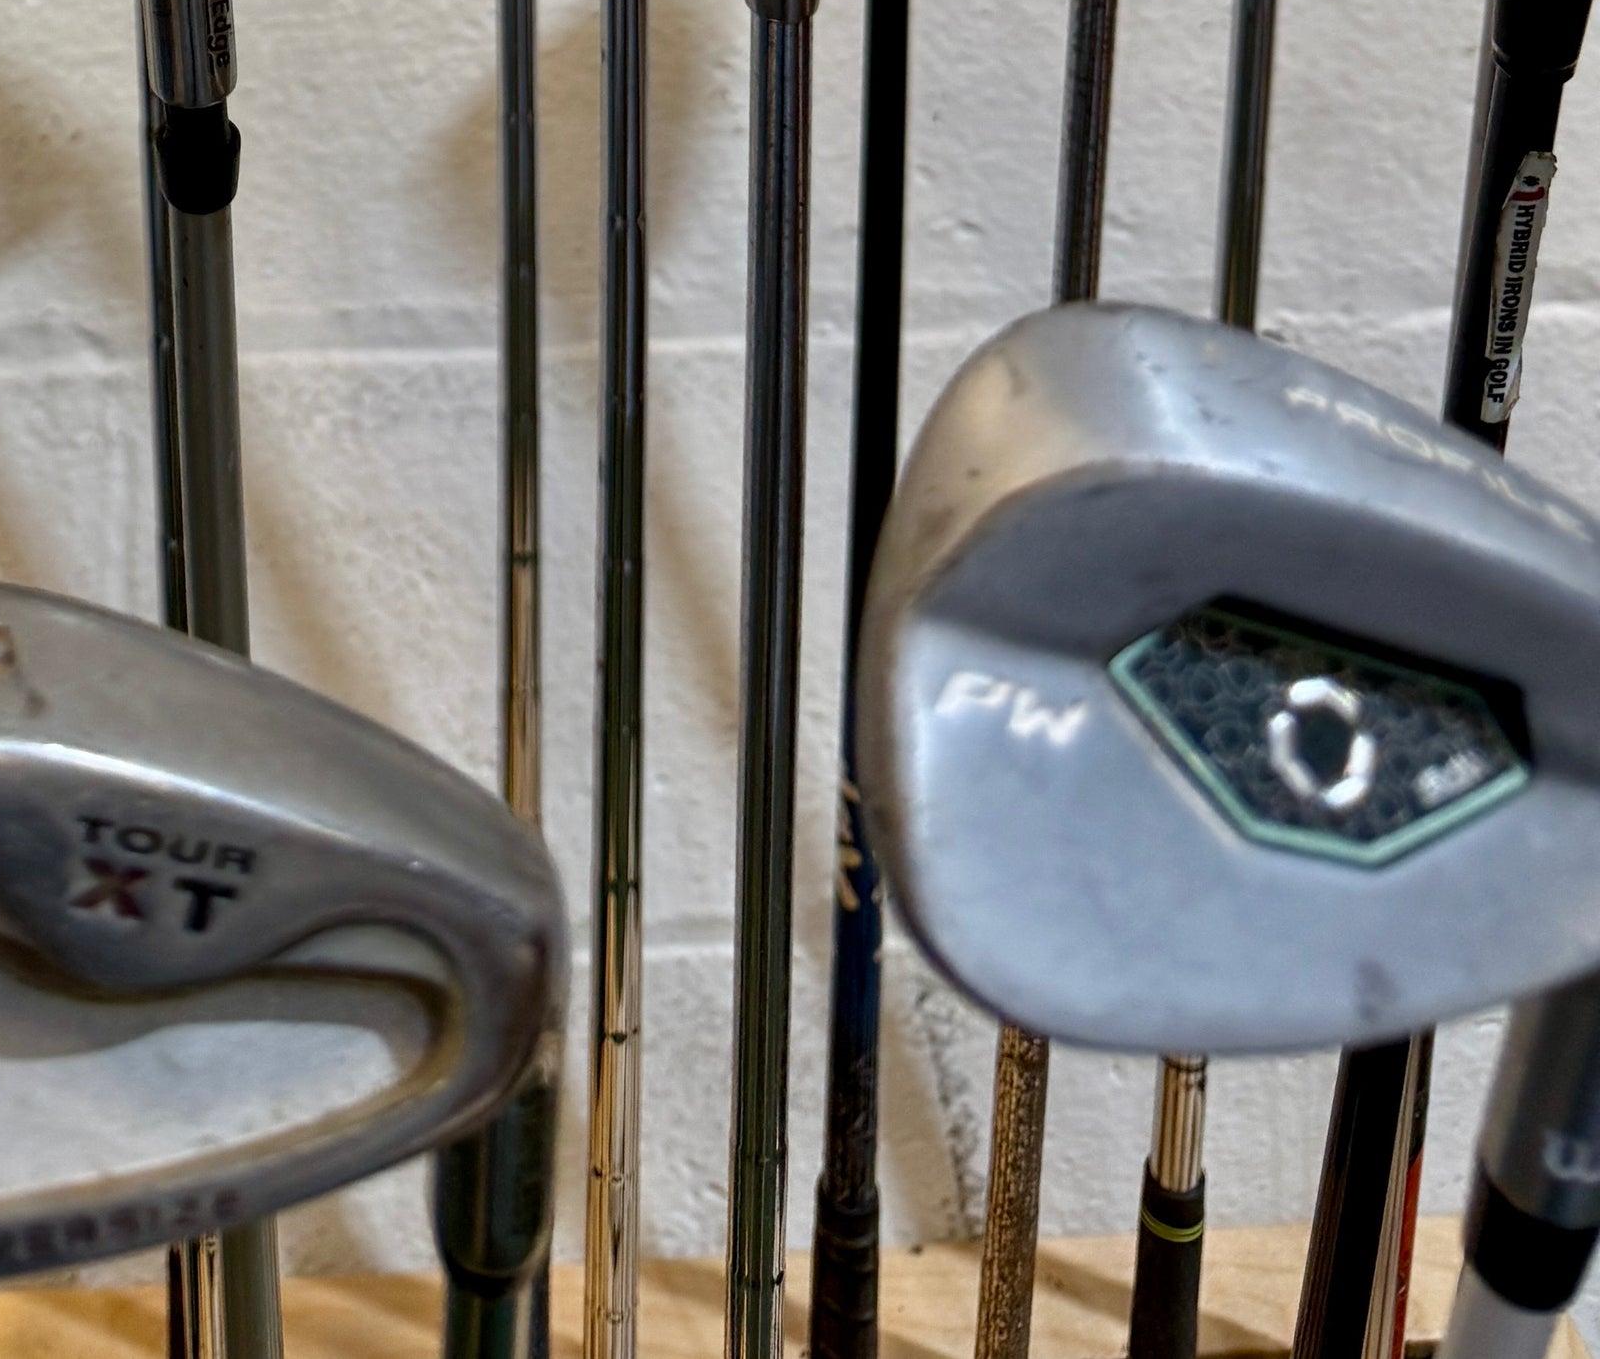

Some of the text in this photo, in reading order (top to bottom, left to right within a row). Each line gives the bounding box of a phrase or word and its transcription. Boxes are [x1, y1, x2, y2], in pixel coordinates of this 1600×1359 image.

[1487, 204, 1537, 404] HYBRID IRONS IN GOLF
[933, 670, 1090, 747] PW
[74, 815, 257, 876] TOUR
[68, 854, 240, 934] XT
